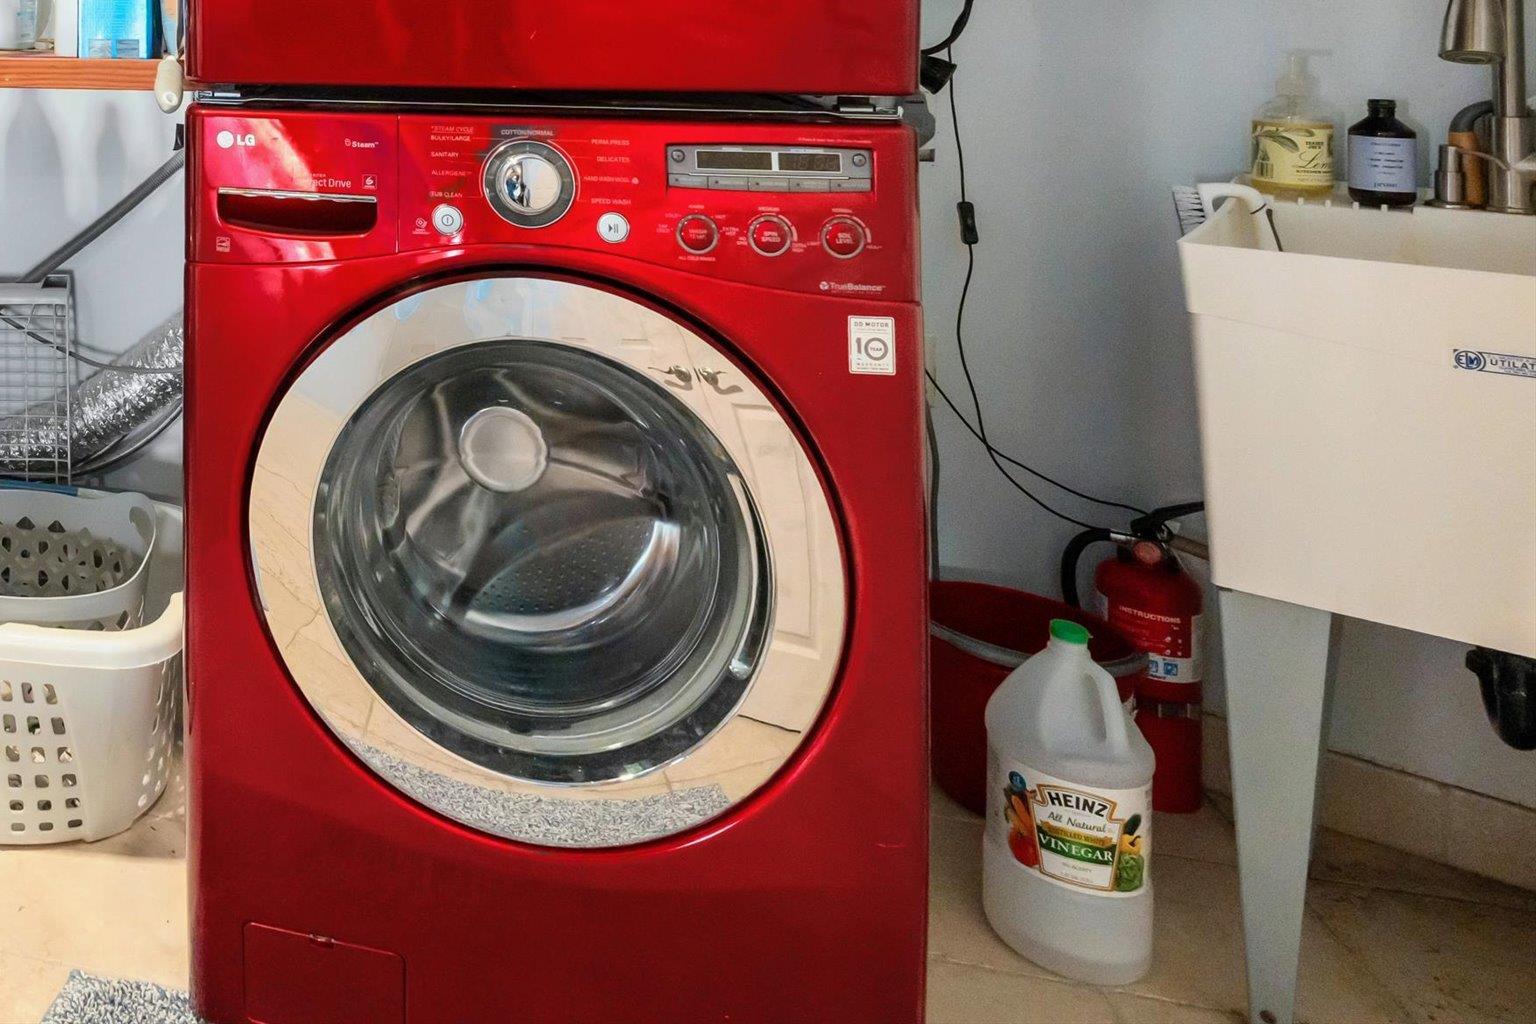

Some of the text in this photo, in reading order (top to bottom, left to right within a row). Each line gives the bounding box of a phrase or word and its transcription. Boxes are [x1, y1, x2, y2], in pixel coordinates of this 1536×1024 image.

[236, 134, 256, 147] LG
[328, 178, 352, 189] Drive
[612, 198, 632, 206] WASH
[855, 337, 888, 361] 10
[1119, 605, 1181, 624] INSTRUCTIONS
[1047, 791, 1109, 818] HEINZ
[1047, 811, 1106, 833] All Natural
[1038, 833, 1113, 861] VINEGAR
